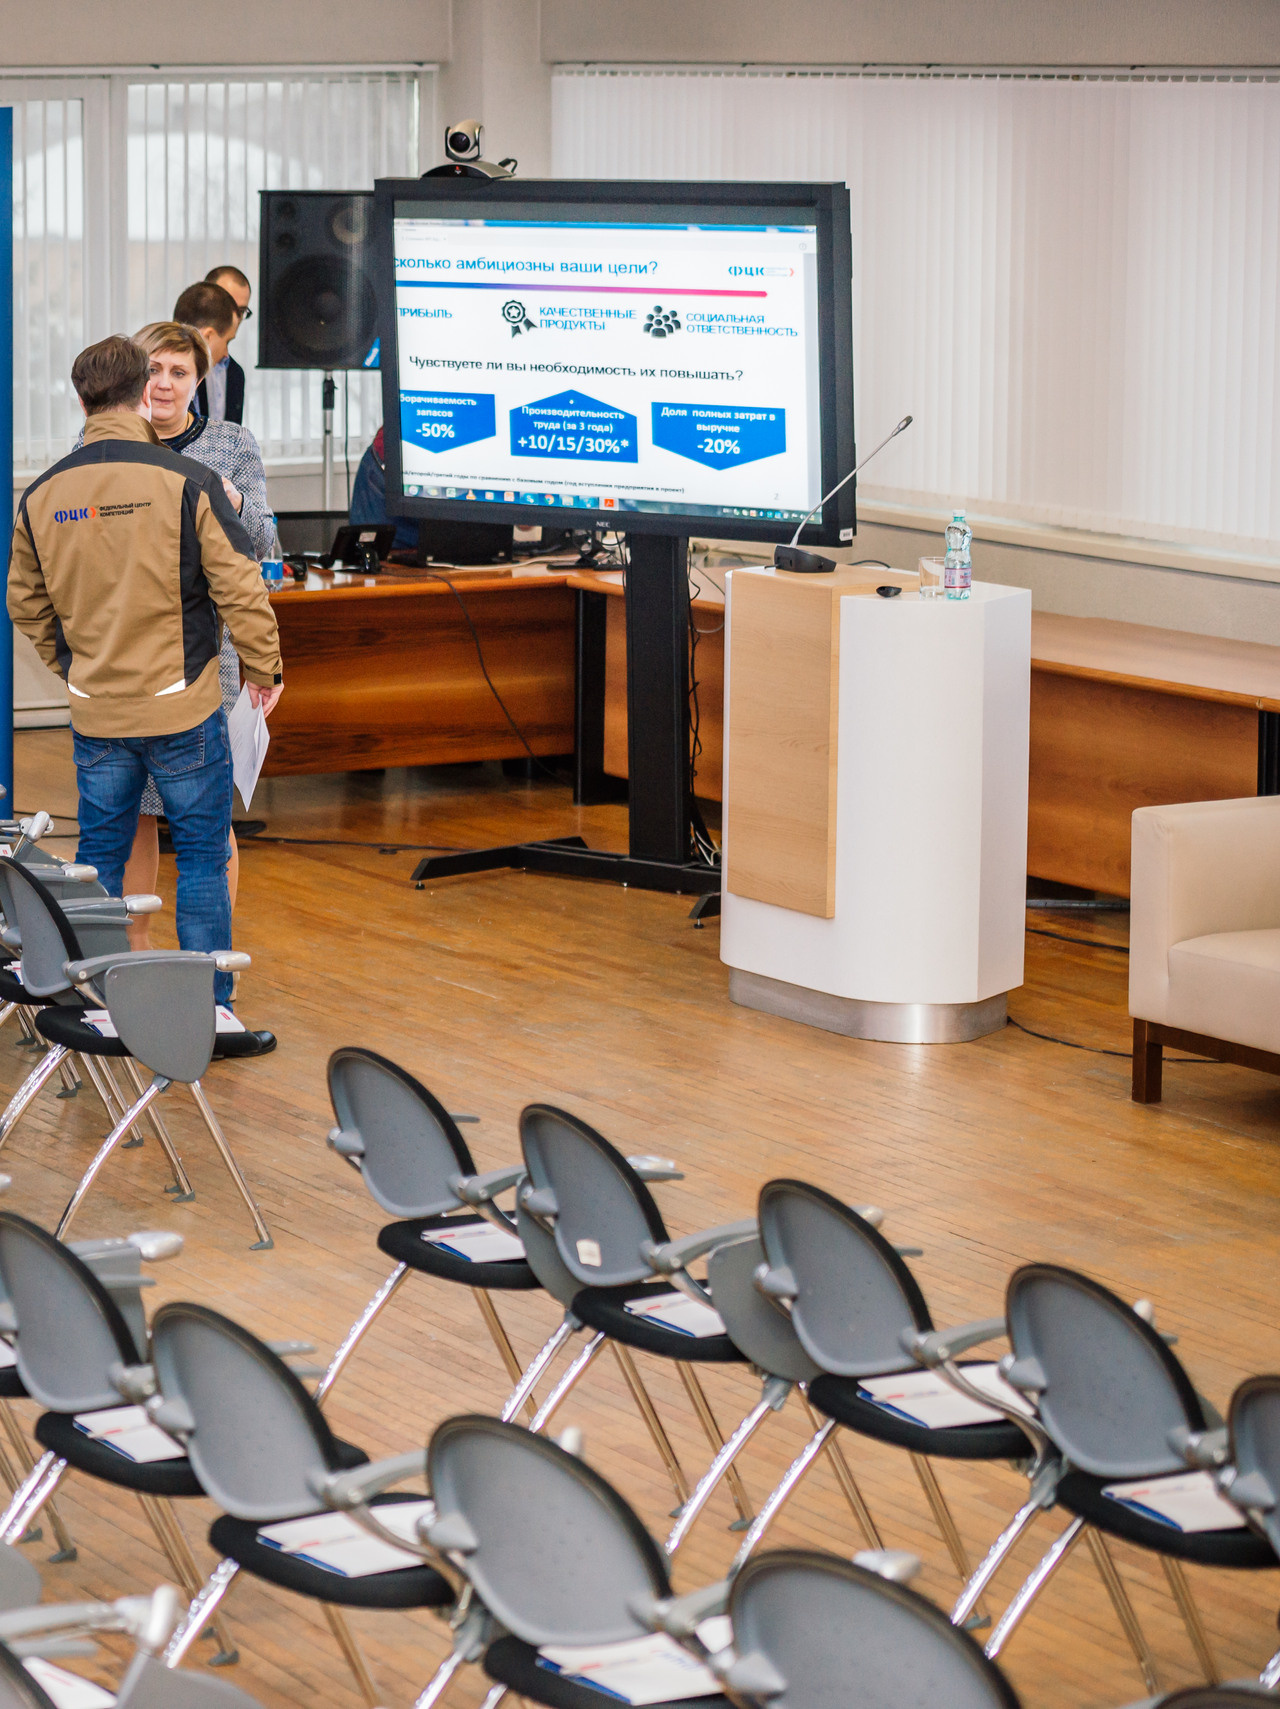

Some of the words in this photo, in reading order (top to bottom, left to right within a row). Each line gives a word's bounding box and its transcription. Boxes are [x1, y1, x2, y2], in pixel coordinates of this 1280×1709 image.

[456, 256, 554, 274] амбициозны
[560, 261, 603, 273] ваши
[608, 260, 658, 276] цели?
[539, 306, 637, 320] КАЧЕСТВЕННЫЕ
[686, 312, 765, 324] СОЦИАЛЬНАЯ
[539, 319, 606, 331] ПРОДУКТЫ
[686, 324, 799, 337] ОТВЕТСТВЕННОСТЬ
[409, 355, 483, 371] Чувствуете
[486, 361, 504, 371] ли
[506, 362, 526, 372] вы
[530, 362, 636, 377] необходимость
[640, 368, 656, 377] их
[660, 368, 744, 381] повышать?
[416, 409, 453, 418] запасов
[521, 406, 625, 420] Производительность
[661, 406, 687, 418] Доля
[692, 409, 732, 419] полных
[734, 411, 767, 422] затрат
[769, 413, 776, 421] в
[416, 423, 455, 438] -50%
[533, 421, 561, 431] труда
[563, 421, 577, 431] (за
[579, 422, 585, 431] 3
[587, 423, 614, 434] года)
[696, 423, 740, 434] выручке
[697, 438, 741, 454] -20%
[54, 507, 89, 524] ФЦК
[595, 520, 611, 528] NEC
